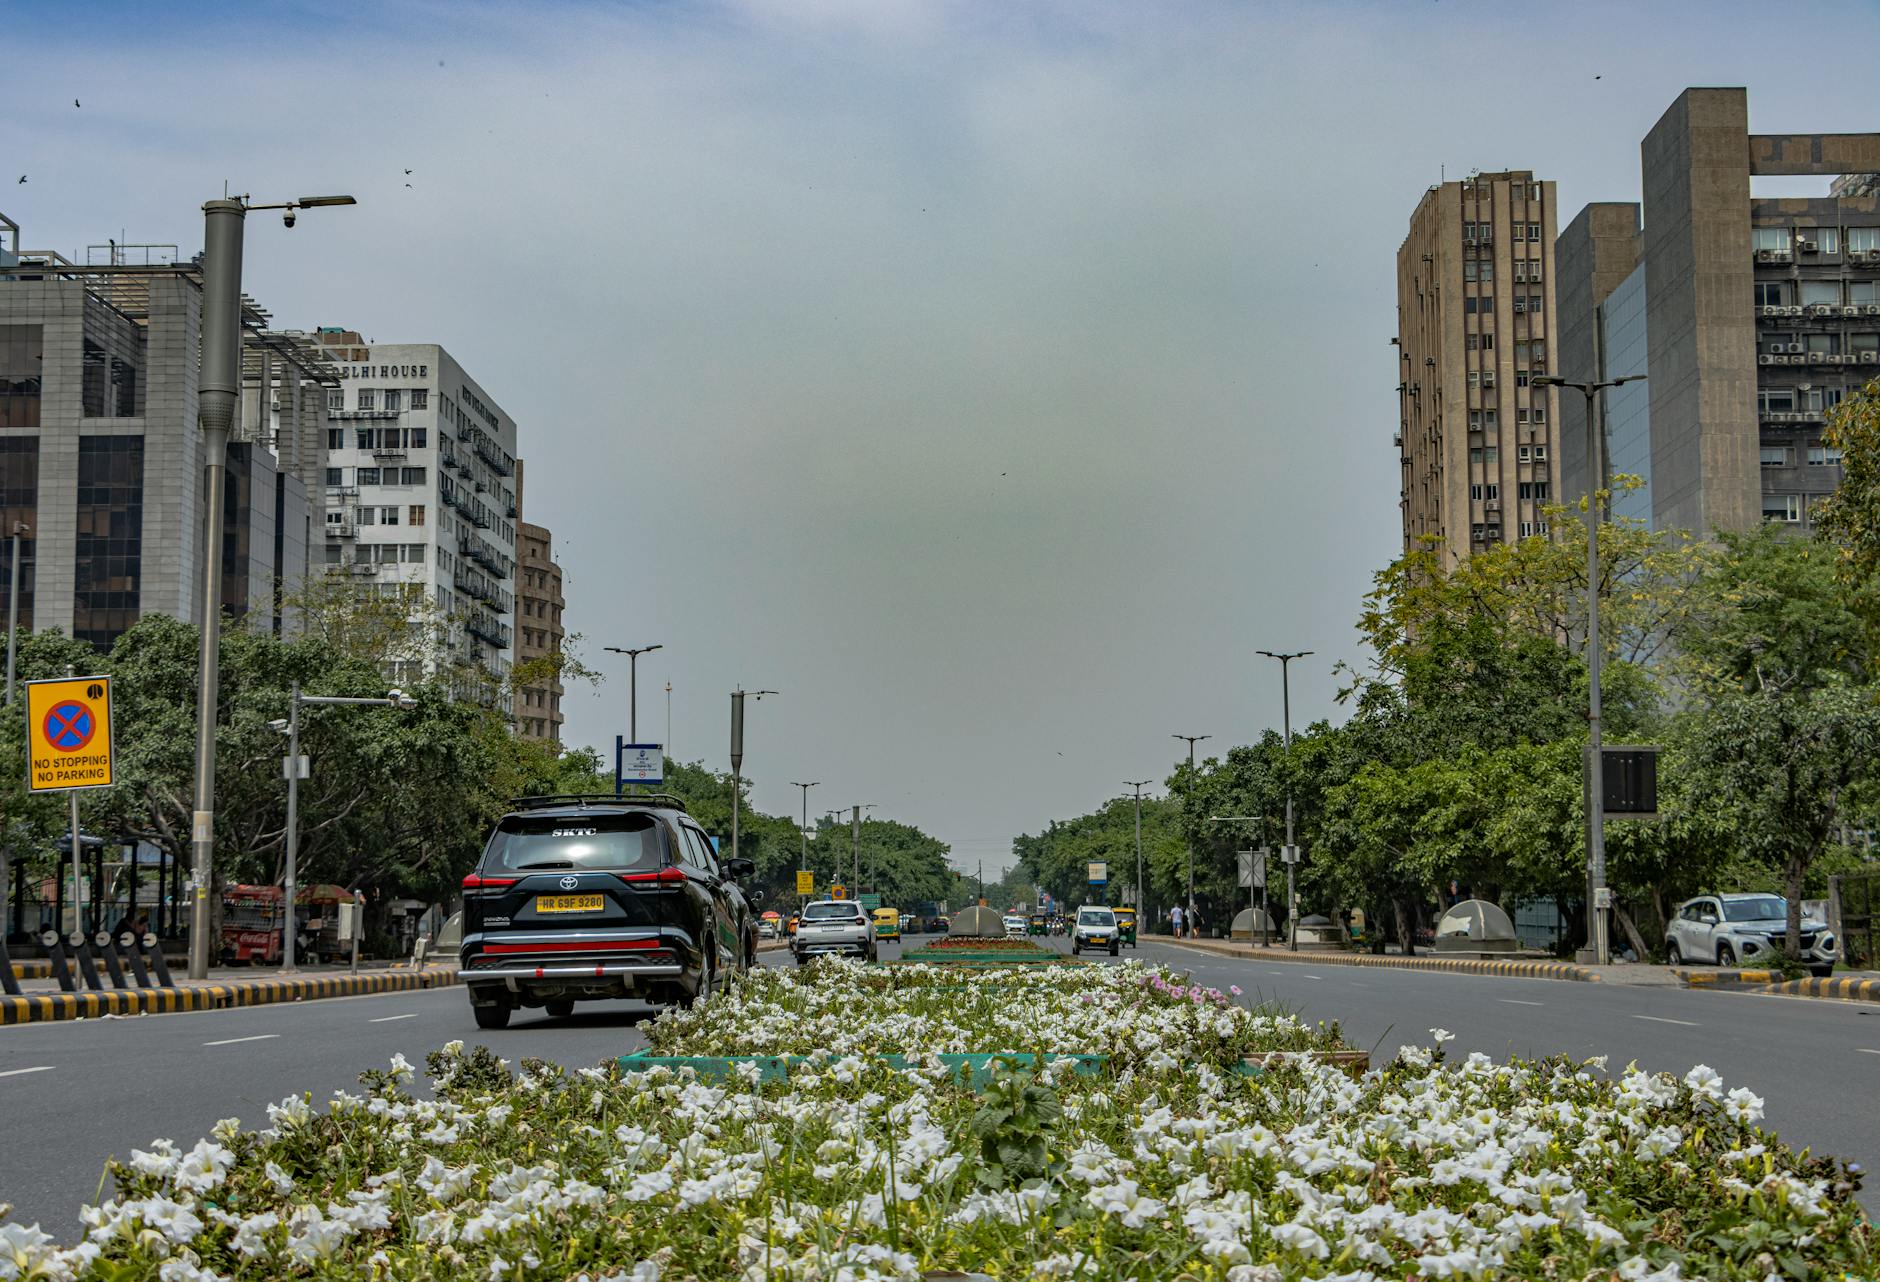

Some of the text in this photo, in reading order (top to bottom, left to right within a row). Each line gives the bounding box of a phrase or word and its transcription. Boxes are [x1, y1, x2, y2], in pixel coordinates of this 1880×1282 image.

[381, 365, 428, 378] HOUSE
[34, 755, 107, 769] NO STOPPING
[38, 769, 105, 782] NO PARKING
[543, 896, 602, 909] HR 69F 9280
